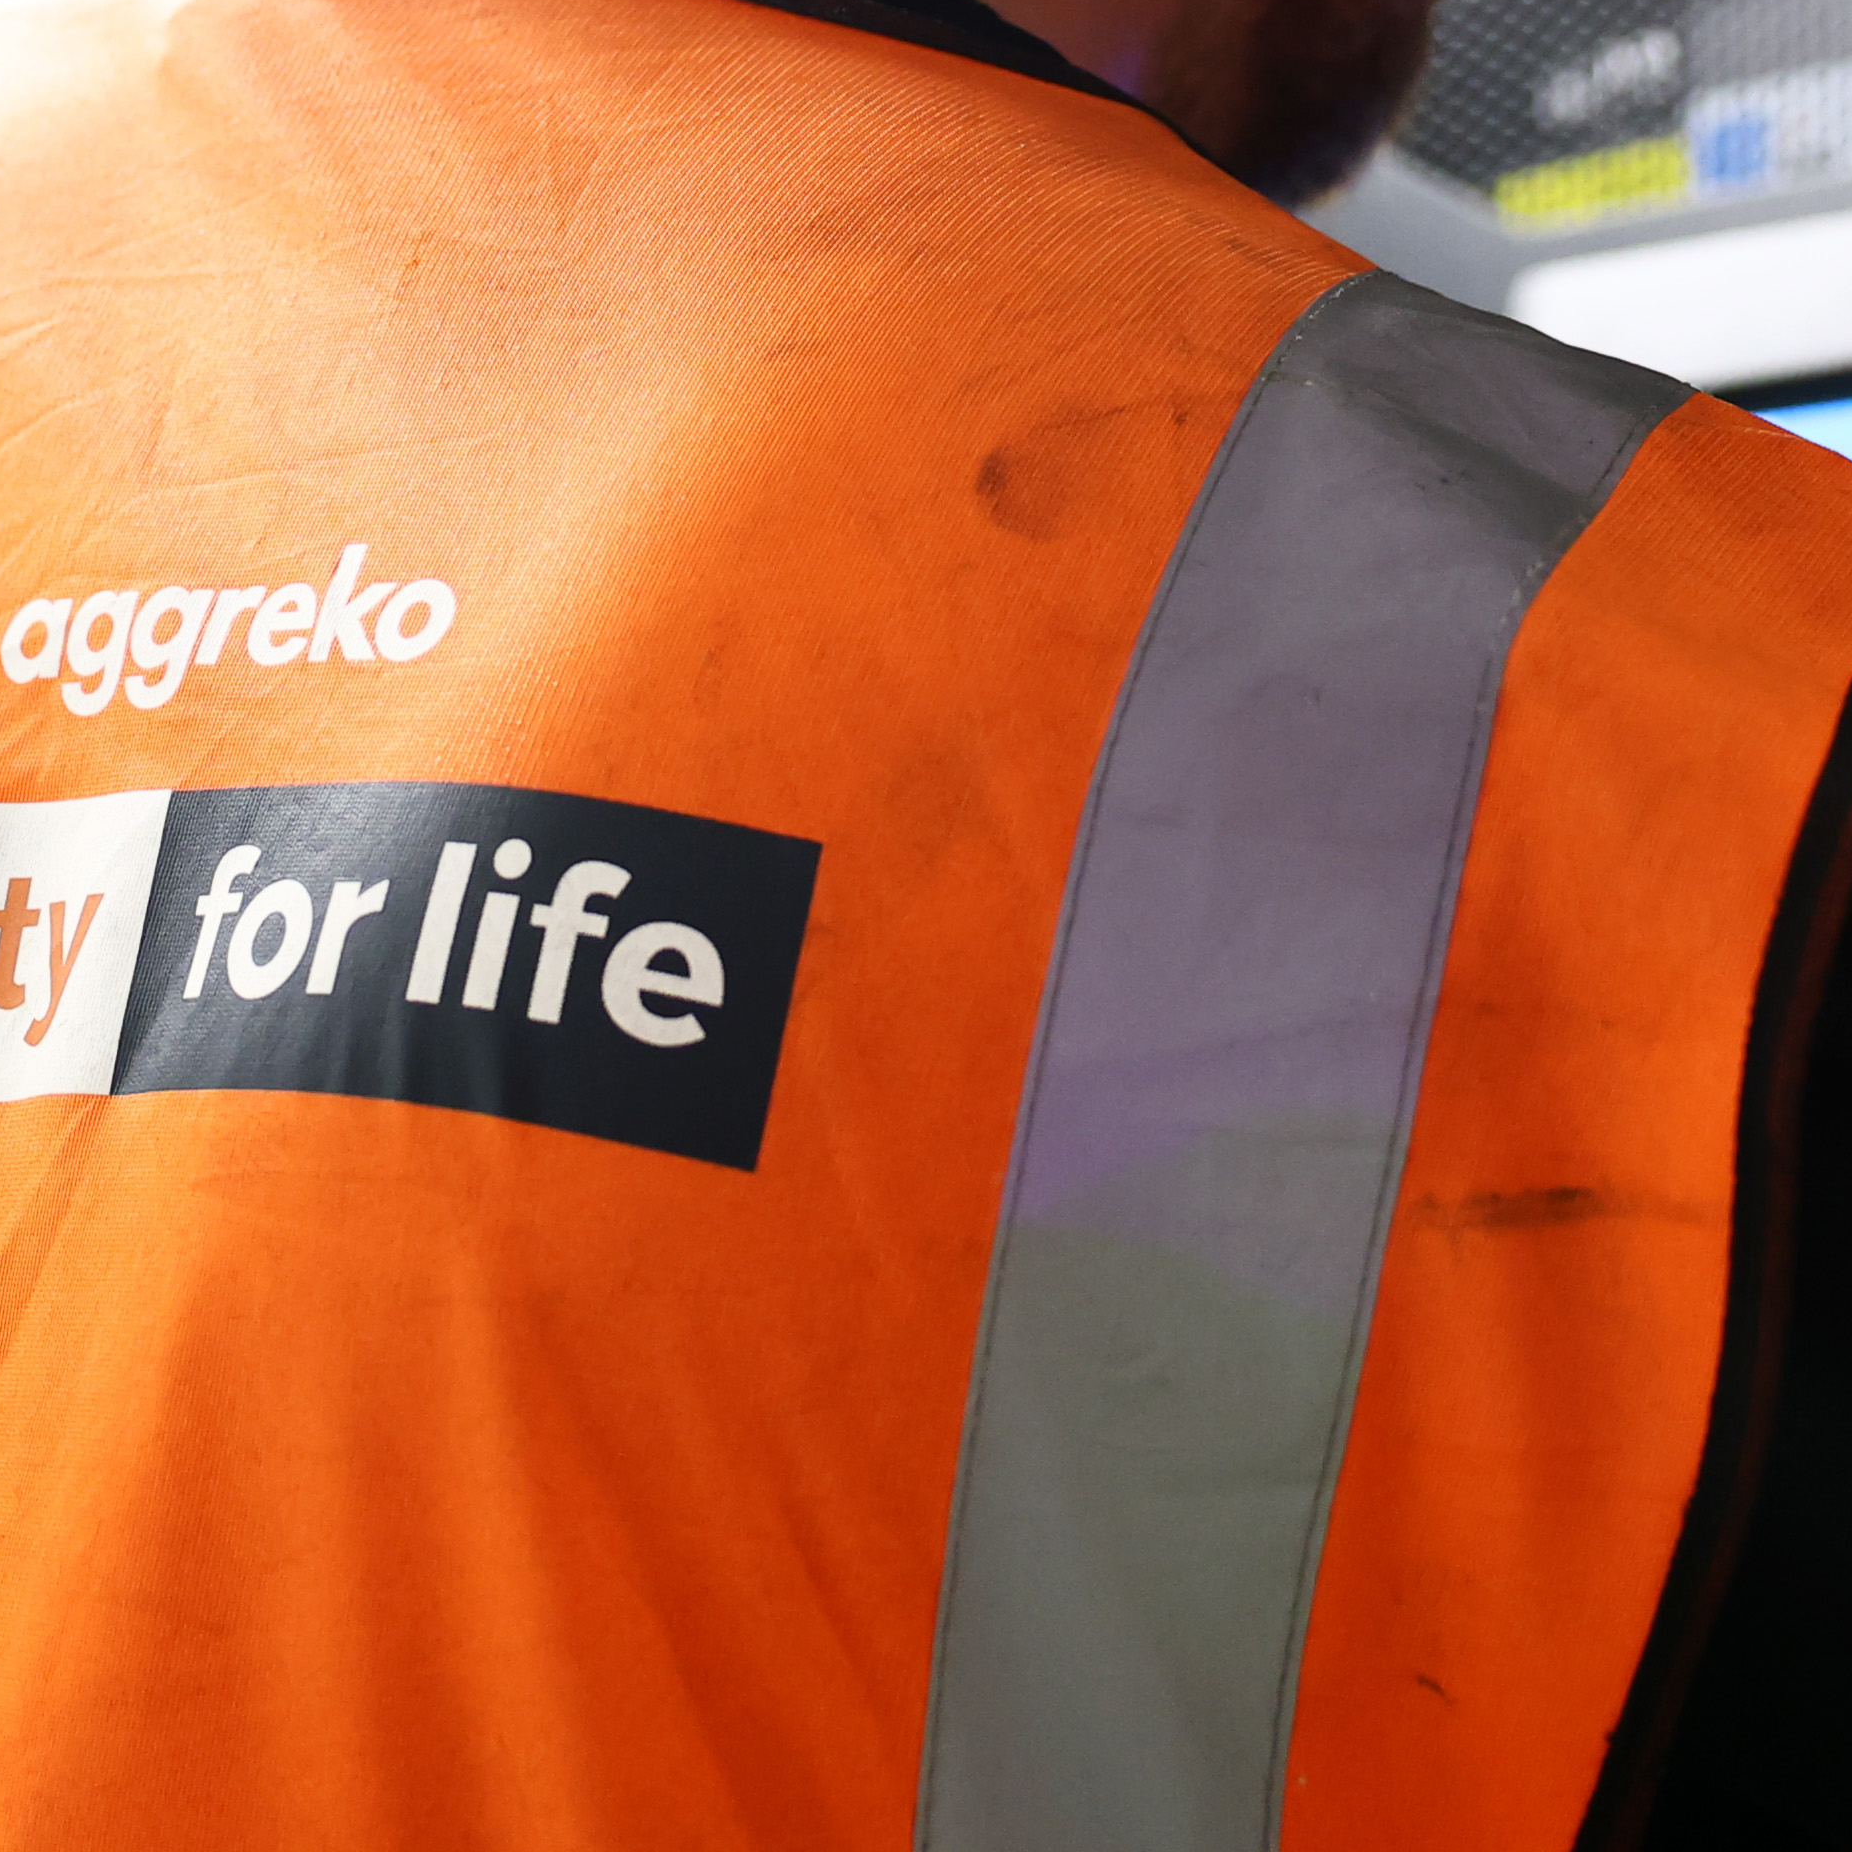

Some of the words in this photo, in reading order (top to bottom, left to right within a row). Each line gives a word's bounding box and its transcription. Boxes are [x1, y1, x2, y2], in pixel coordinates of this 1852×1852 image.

[0, 543, 457, 717] aggreko
[181, 843, 391, 1001] for
[405, 837, 726, 1048] life
